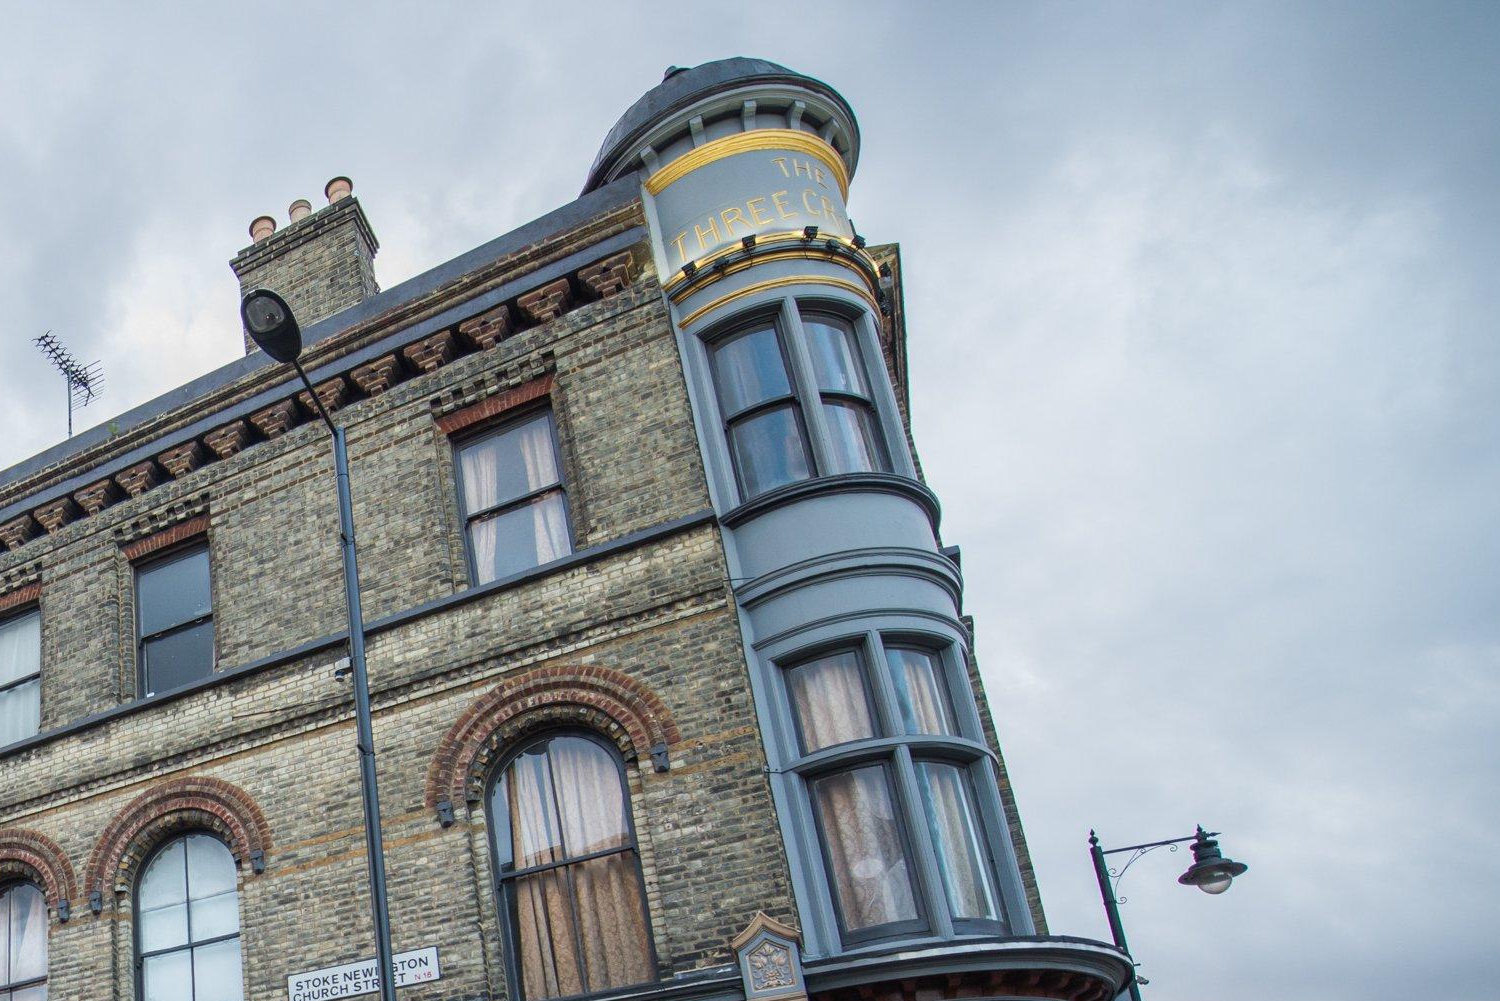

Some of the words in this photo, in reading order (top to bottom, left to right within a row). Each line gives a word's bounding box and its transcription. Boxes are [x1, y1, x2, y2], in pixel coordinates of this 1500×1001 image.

[771, 156, 830, 191] THE
[669, 189, 799, 263] THREE
[295, 973, 339, 992] STOKE
[343, 956, 430, 983] NEWIGTON
[353, 972, 407, 992] STRET
